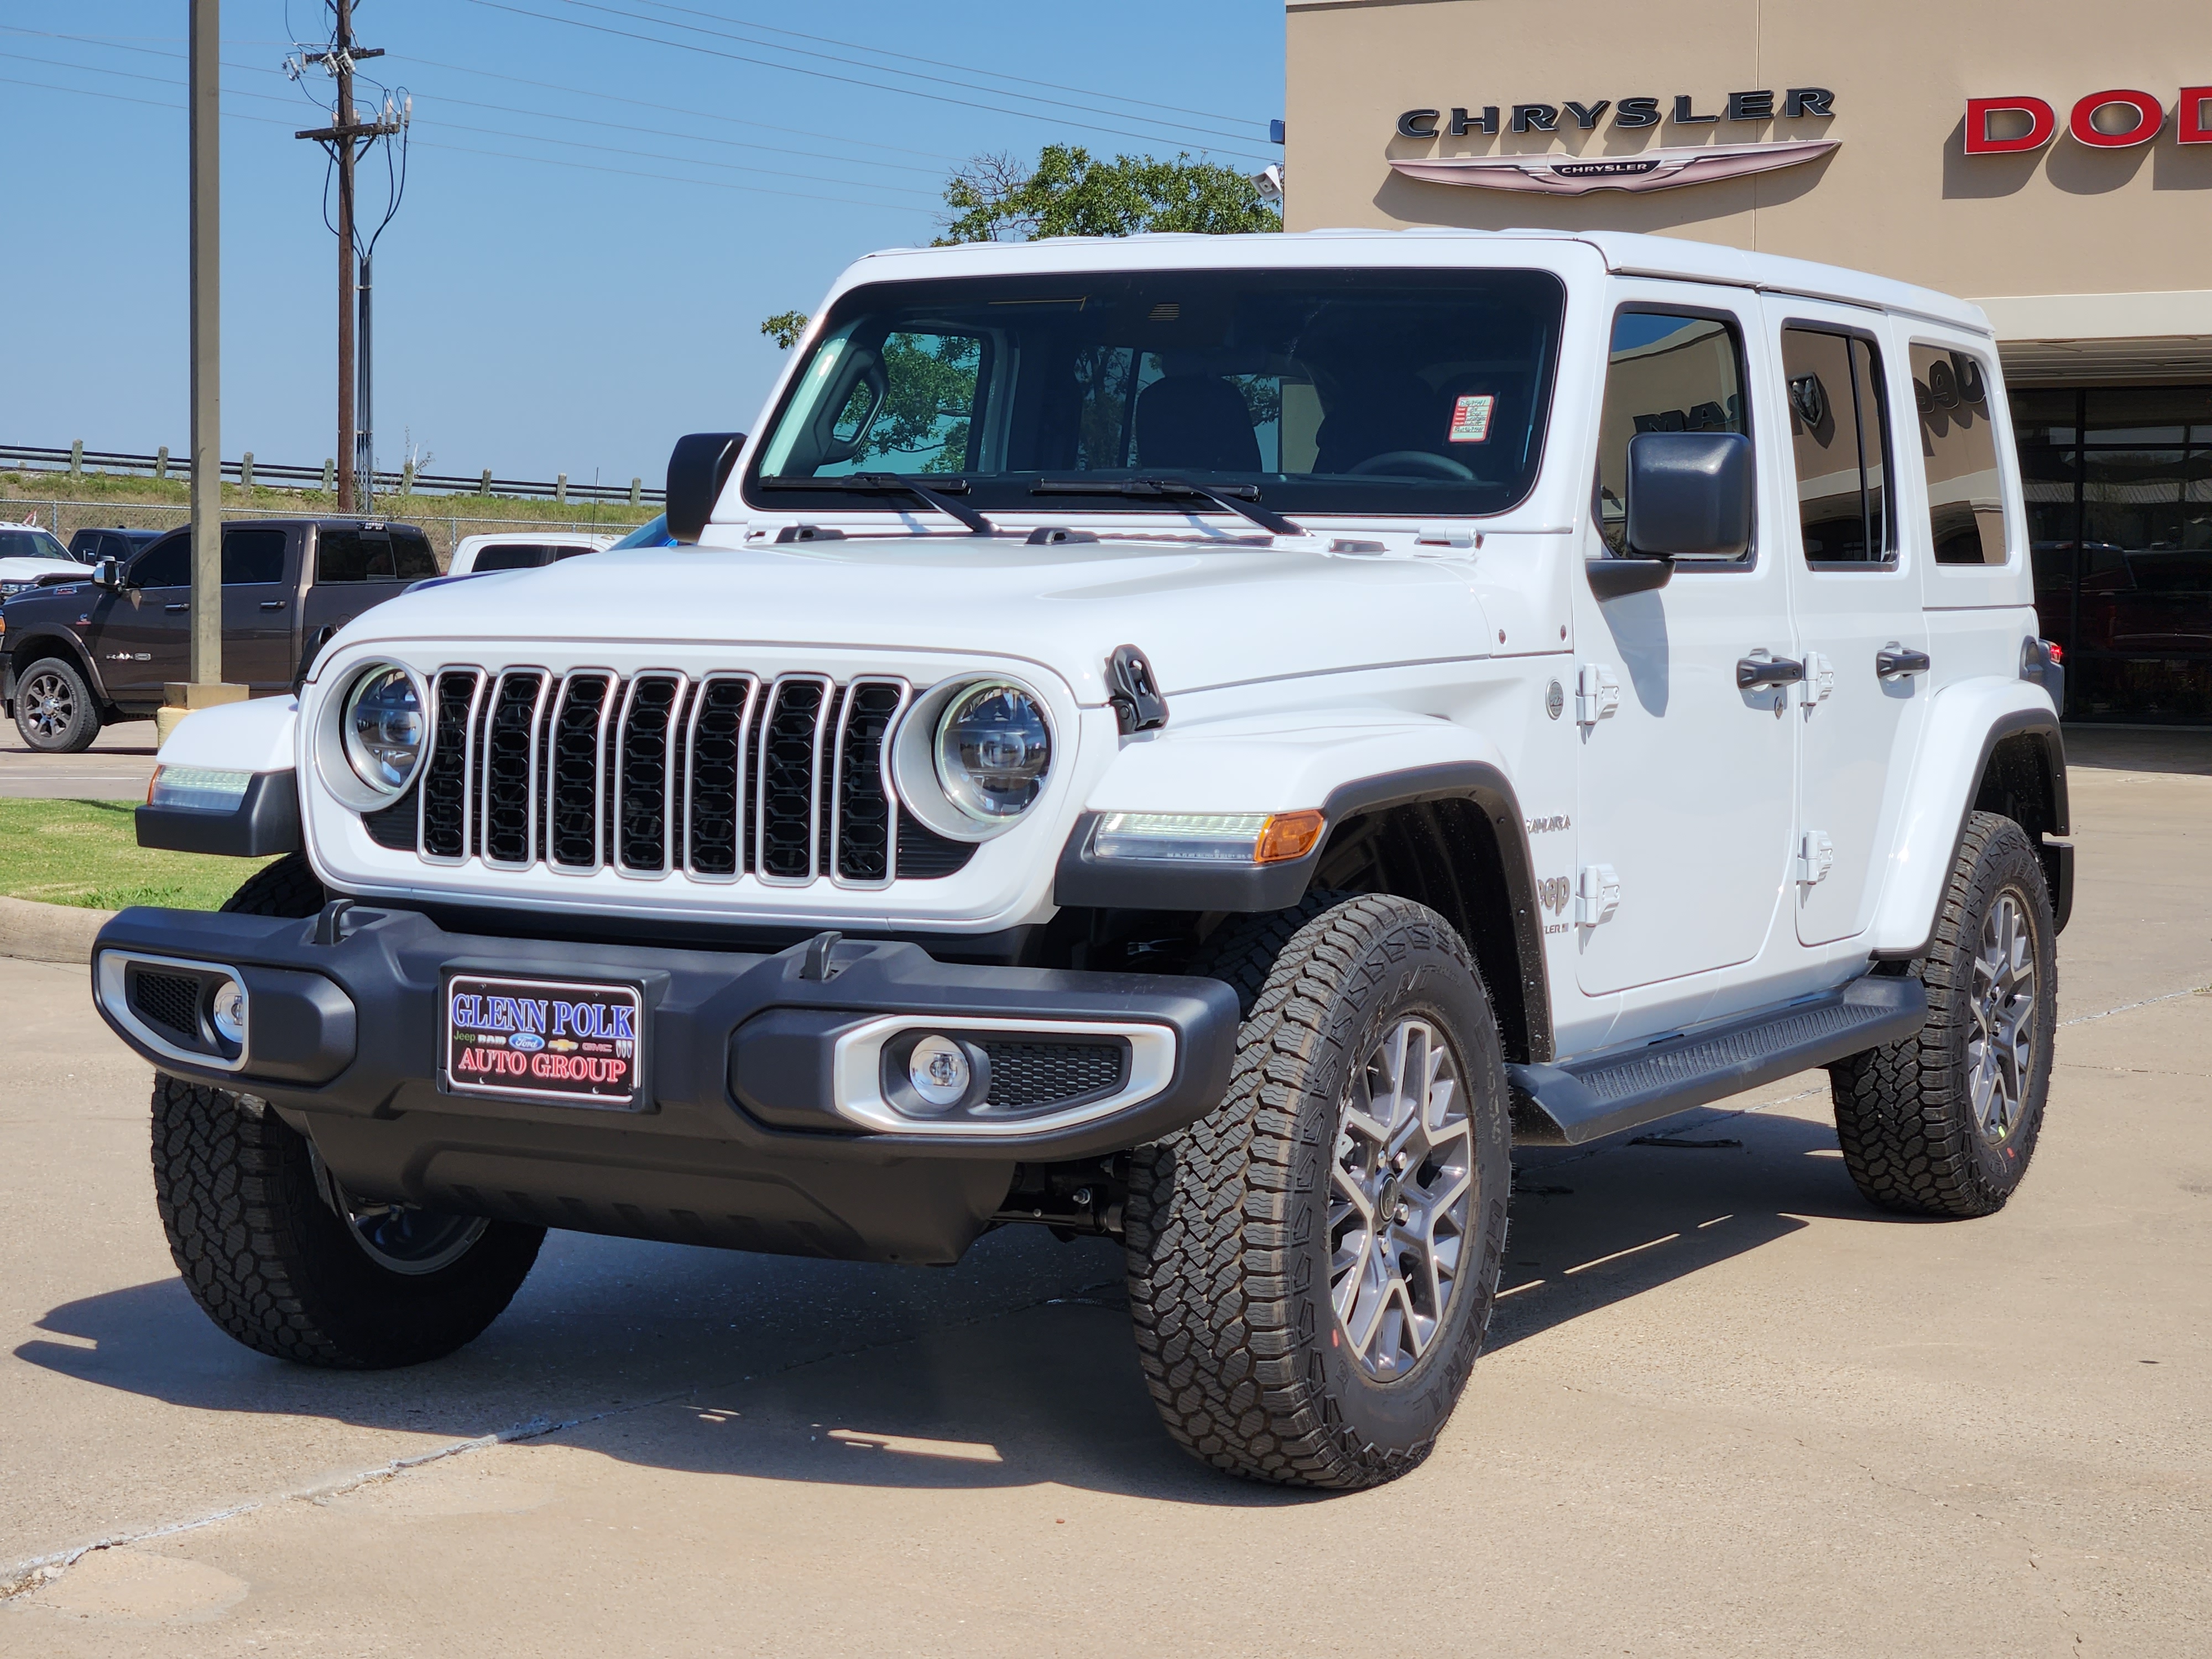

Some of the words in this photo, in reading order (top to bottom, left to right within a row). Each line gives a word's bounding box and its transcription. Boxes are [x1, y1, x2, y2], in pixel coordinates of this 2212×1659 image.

[1396, 87, 1835, 138] CHRYSLER
[1561, 163, 1647, 174] CHRYSLER
[452, 993, 548, 1034] GLENN
[552, 1001, 635, 1039] POLK
[453, 1030, 476, 1043] Jeep
[478, 1034, 506, 1045] RAM
[582, 1042, 612, 1052] GMC
[458, 1047, 527, 1075] AUTO
[531, 1053, 627, 1083] GROUP
